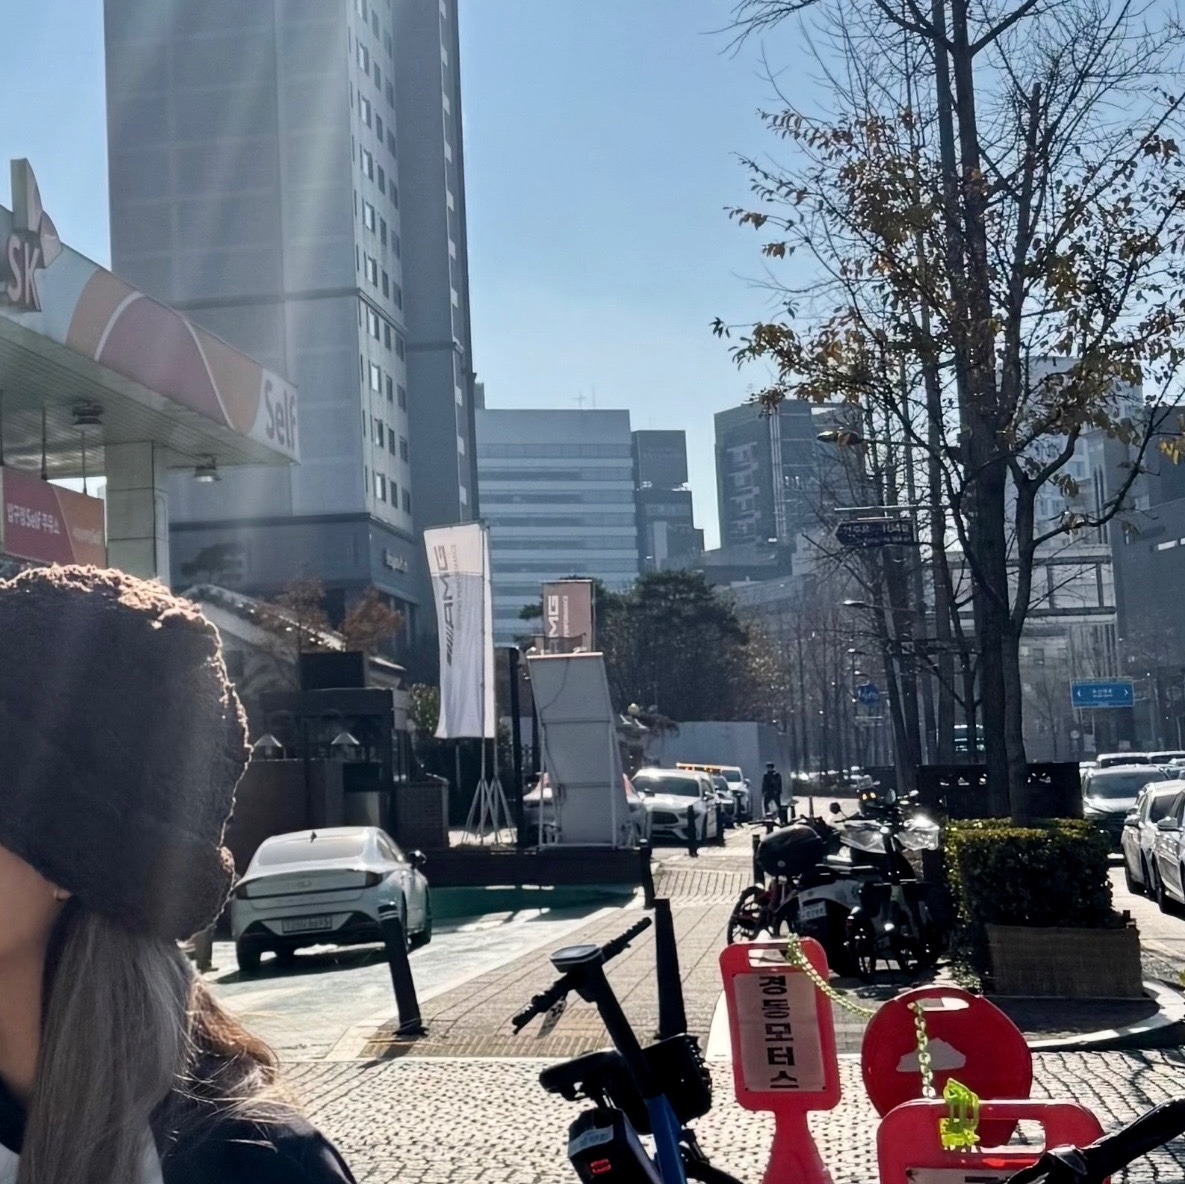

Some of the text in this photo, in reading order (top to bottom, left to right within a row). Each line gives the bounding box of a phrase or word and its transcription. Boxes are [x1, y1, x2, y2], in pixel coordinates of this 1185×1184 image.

[7, 234, 41, 311] SK
[265, 379, 296, 451] Self
[434, 545, 454, 628] AMG
